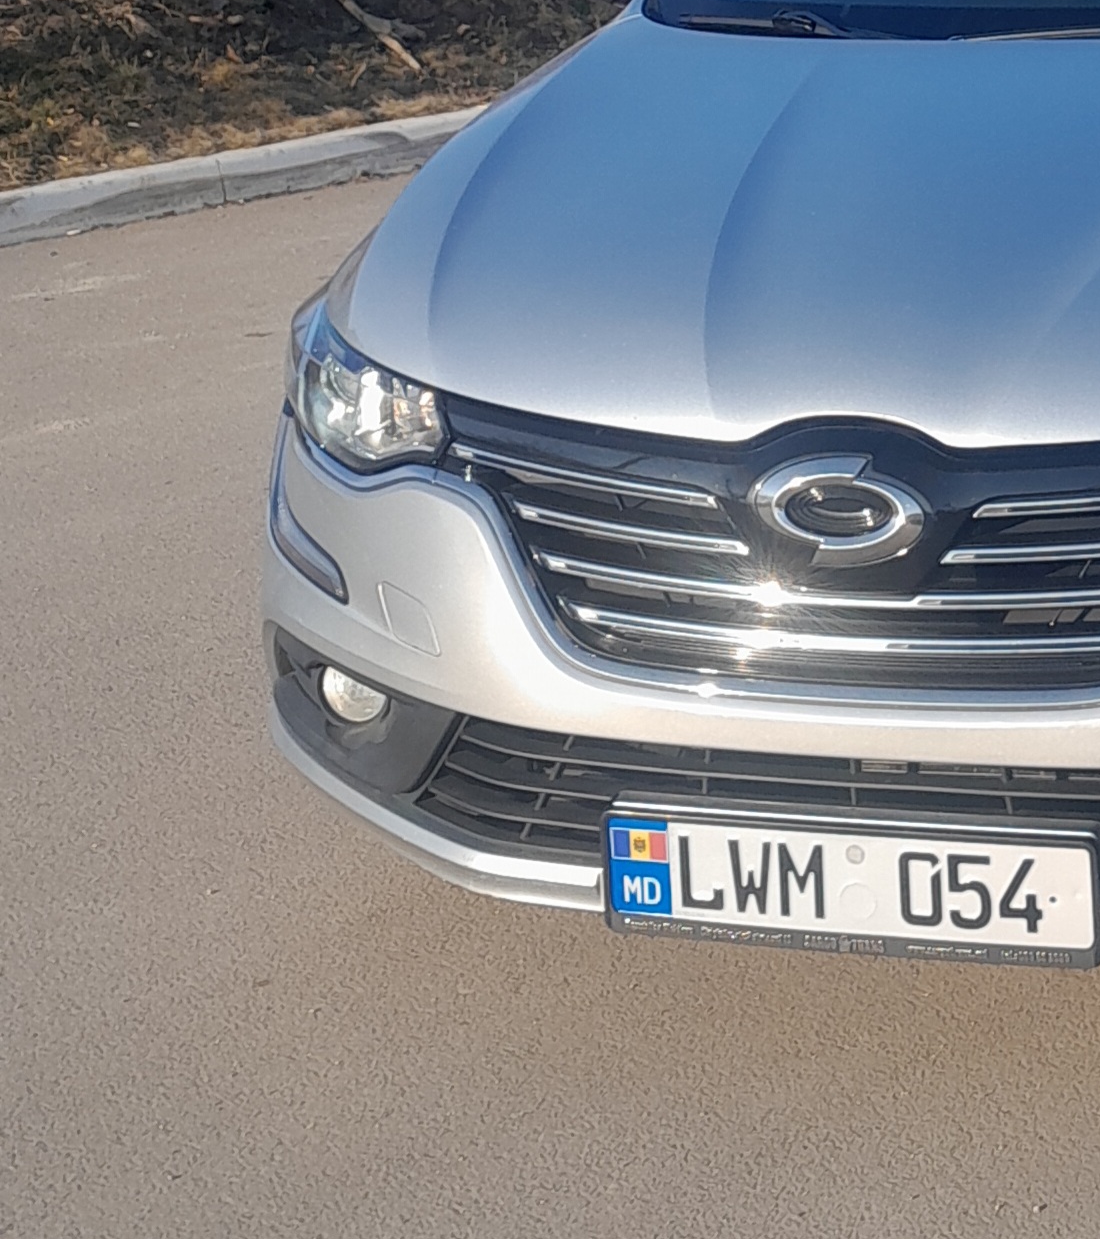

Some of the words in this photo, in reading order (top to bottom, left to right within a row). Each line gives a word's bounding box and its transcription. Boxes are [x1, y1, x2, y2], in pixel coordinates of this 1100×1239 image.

[623, 874, 661, 905] MD
[678, 835, 825, 919] LWM
[899, 852, 1043, 933] 054
